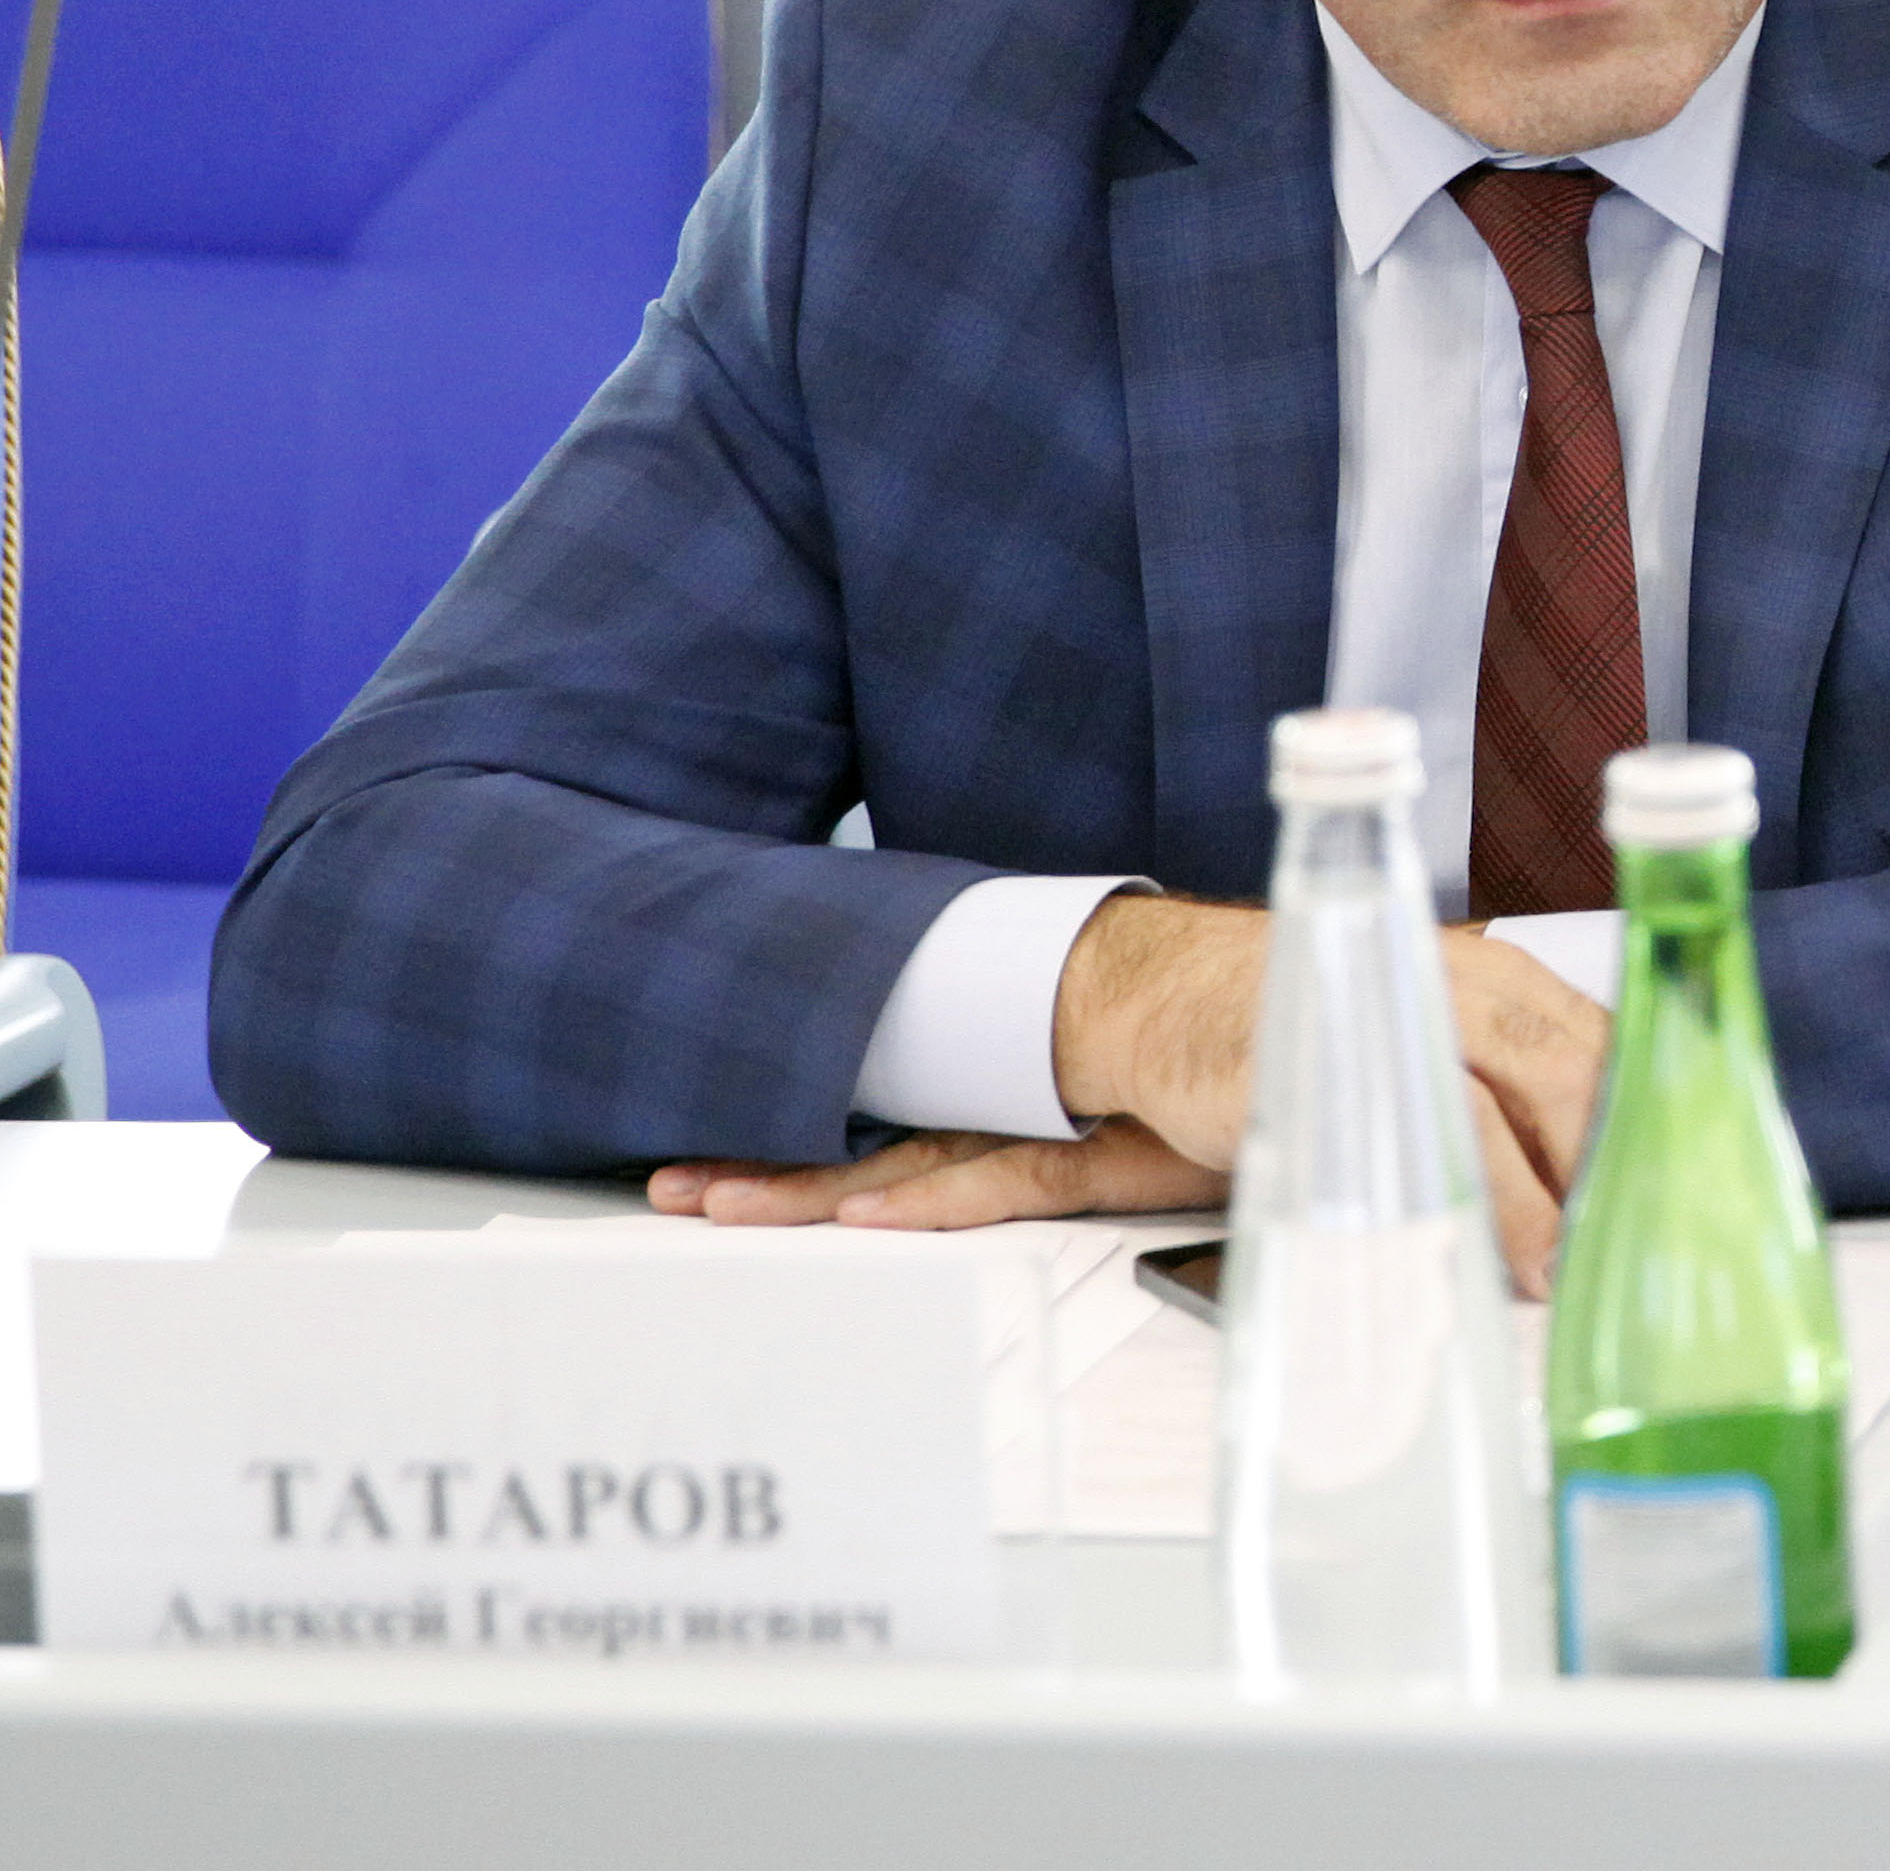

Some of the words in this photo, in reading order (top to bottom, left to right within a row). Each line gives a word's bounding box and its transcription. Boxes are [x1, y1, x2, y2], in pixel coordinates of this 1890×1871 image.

[243, 1459, 785, 1545] ТАТАРОВ
[154, 1586, 448, 1646] Алексей
[474, 1586, 892, 1657] Георгиевич
